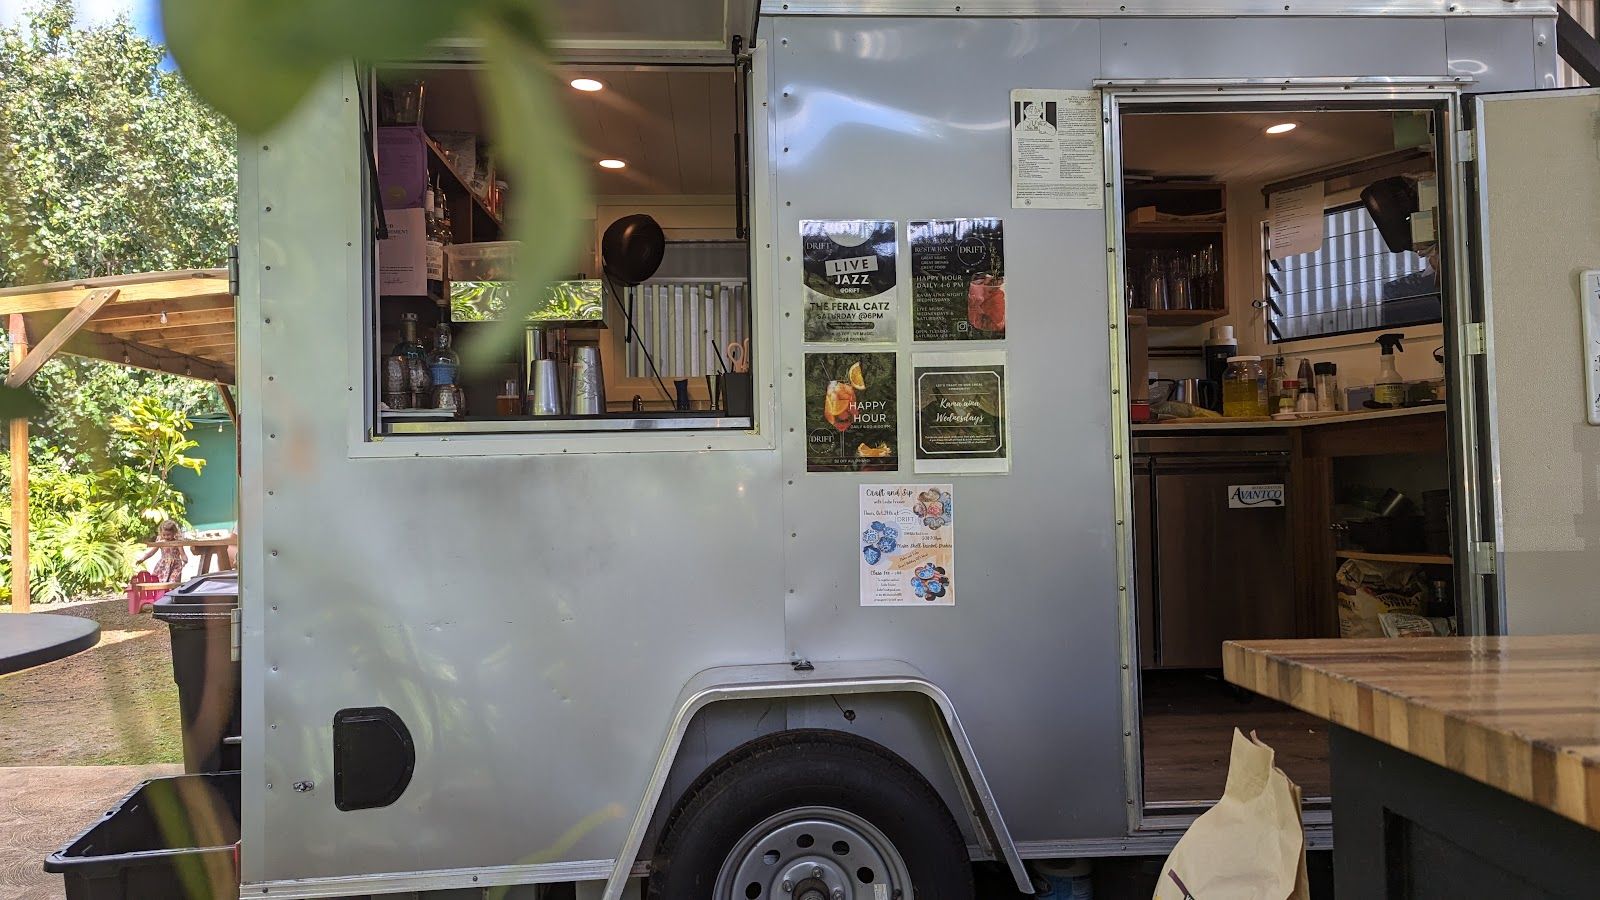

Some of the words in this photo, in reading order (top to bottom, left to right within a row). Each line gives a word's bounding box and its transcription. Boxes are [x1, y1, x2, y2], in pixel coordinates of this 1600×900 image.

[807, 242, 831, 250] DRIFT
[960, 246, 983, 254] DRIFT
[834, 259, 869, 272] LIVE
[835, 274, 869, 285] JAZZ
[810, 302, 829, 311] THE
[832, 302, 861, 311] FERAL
[863, 302, 890, 311] CATZ
[850, 401, 886, 410] HAPPY
[854, 414, 886, 422] HOUR
[936, 412, 984, 425] Wednesdays
[866, 488, 885, 496] Craft
[887, 488, 899, 496] and
[902, 488, 913, 497] Sip
[1231, 487, 1282, 503] AVANTCO
